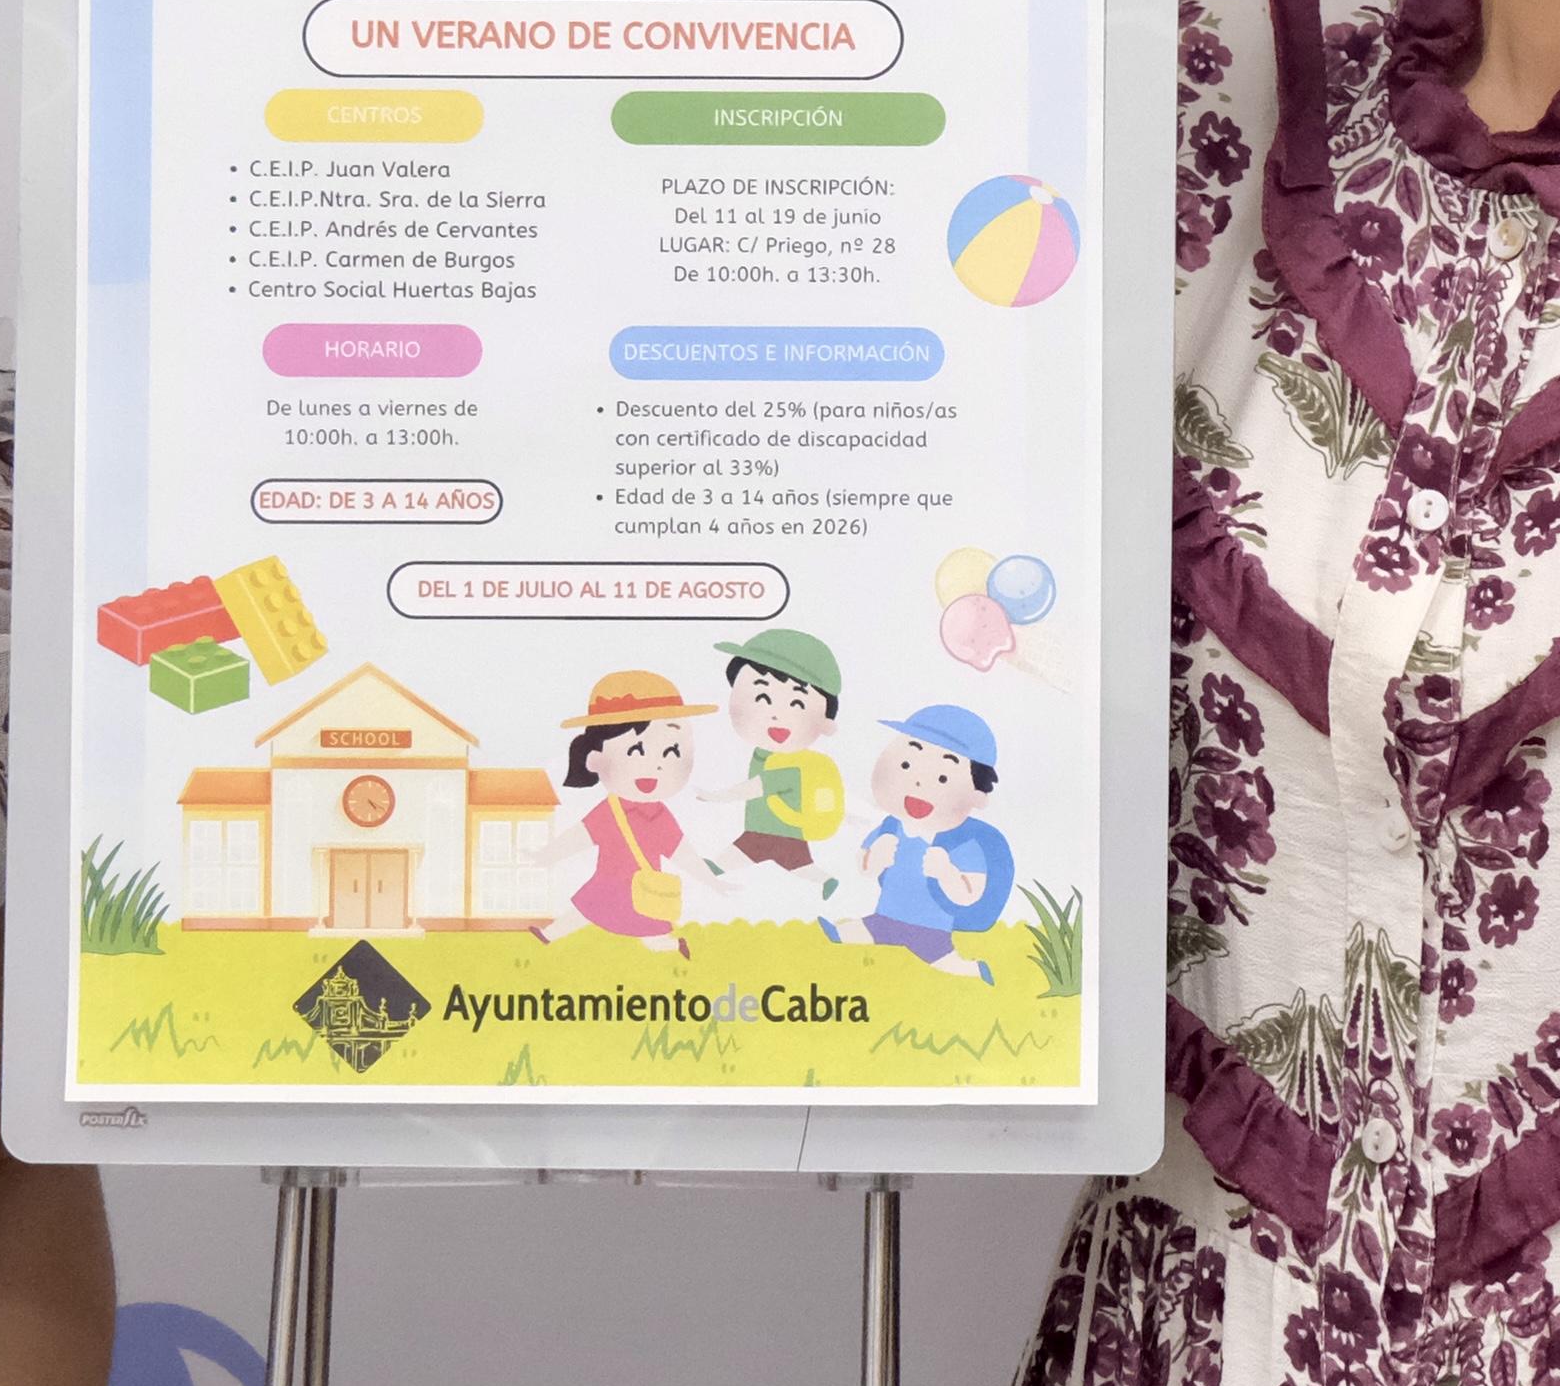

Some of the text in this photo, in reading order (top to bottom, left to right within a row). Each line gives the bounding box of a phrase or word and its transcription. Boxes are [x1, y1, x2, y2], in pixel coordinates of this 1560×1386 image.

[351, 19, 856, 51] UN VERANO DE CONVIVENCIA
[327, 106, 423, 126] CENTROS
[714, 105, 843, 127] INSCRIPCIÓN
[249, 159, 451, 179] C.E.I.P. Juan Valera
[662, 175, 895, 196] PLAZO DE INSCRIPCIÓN:
[379, 190, 419, 208] Sra.
[426, 190, 452, 208] de
[459, 190, 479, 209] la
[486, 191, 546, 209] Sierra
[675, 206, 882, 230] Del 11 al 19 de junio
[249, 220, 538, 239] C.E.I.P. Andrés de Cervantes
[659, 236, 730, 253] LUGAR:
[737, 236, 759, 254] C/
[766, 236, 833, 258] Priego,
[872, 237, 896, 255] 28
[248, 250, 515, 274] C.E.I.P. Carmen de Burgos
[674, 265, 880, 284] De 10:00h. a 13:30h.
[248, 280, 537, 304] Centro Social Huertas Bajas
[325, 340, 421, 360] HORARIO
[624, 340, 930, 362] DESCUENTOS E INFORMACIÓN
[267, 399, 478, 417] De lunes a viernes de
[616, 400, 958, 422] Descuento del 25% (para niños/as
[285, 428, 459, 446] 10:00h. a 13:00h.
[615, 429, 927, 452] con certificado de discapacidad
[615, 458, 779, 480] superior al 33%)
[259, 488, 496, 511] EDAD: DE 3 A 14 AÑOS
[615, 487, 953, 511] Edad de 3 a 14 años (siempre que
[614, 517, 868, 539] cumplan 4 años en 2026)
[418, 579, 766, 600] DEL 1 DE JULIO AL 11 DE AGOSTO
[329, 731, 402, 748] SCHOOL
[442, 982, 871, 1031] AyuntamientodeCabra
